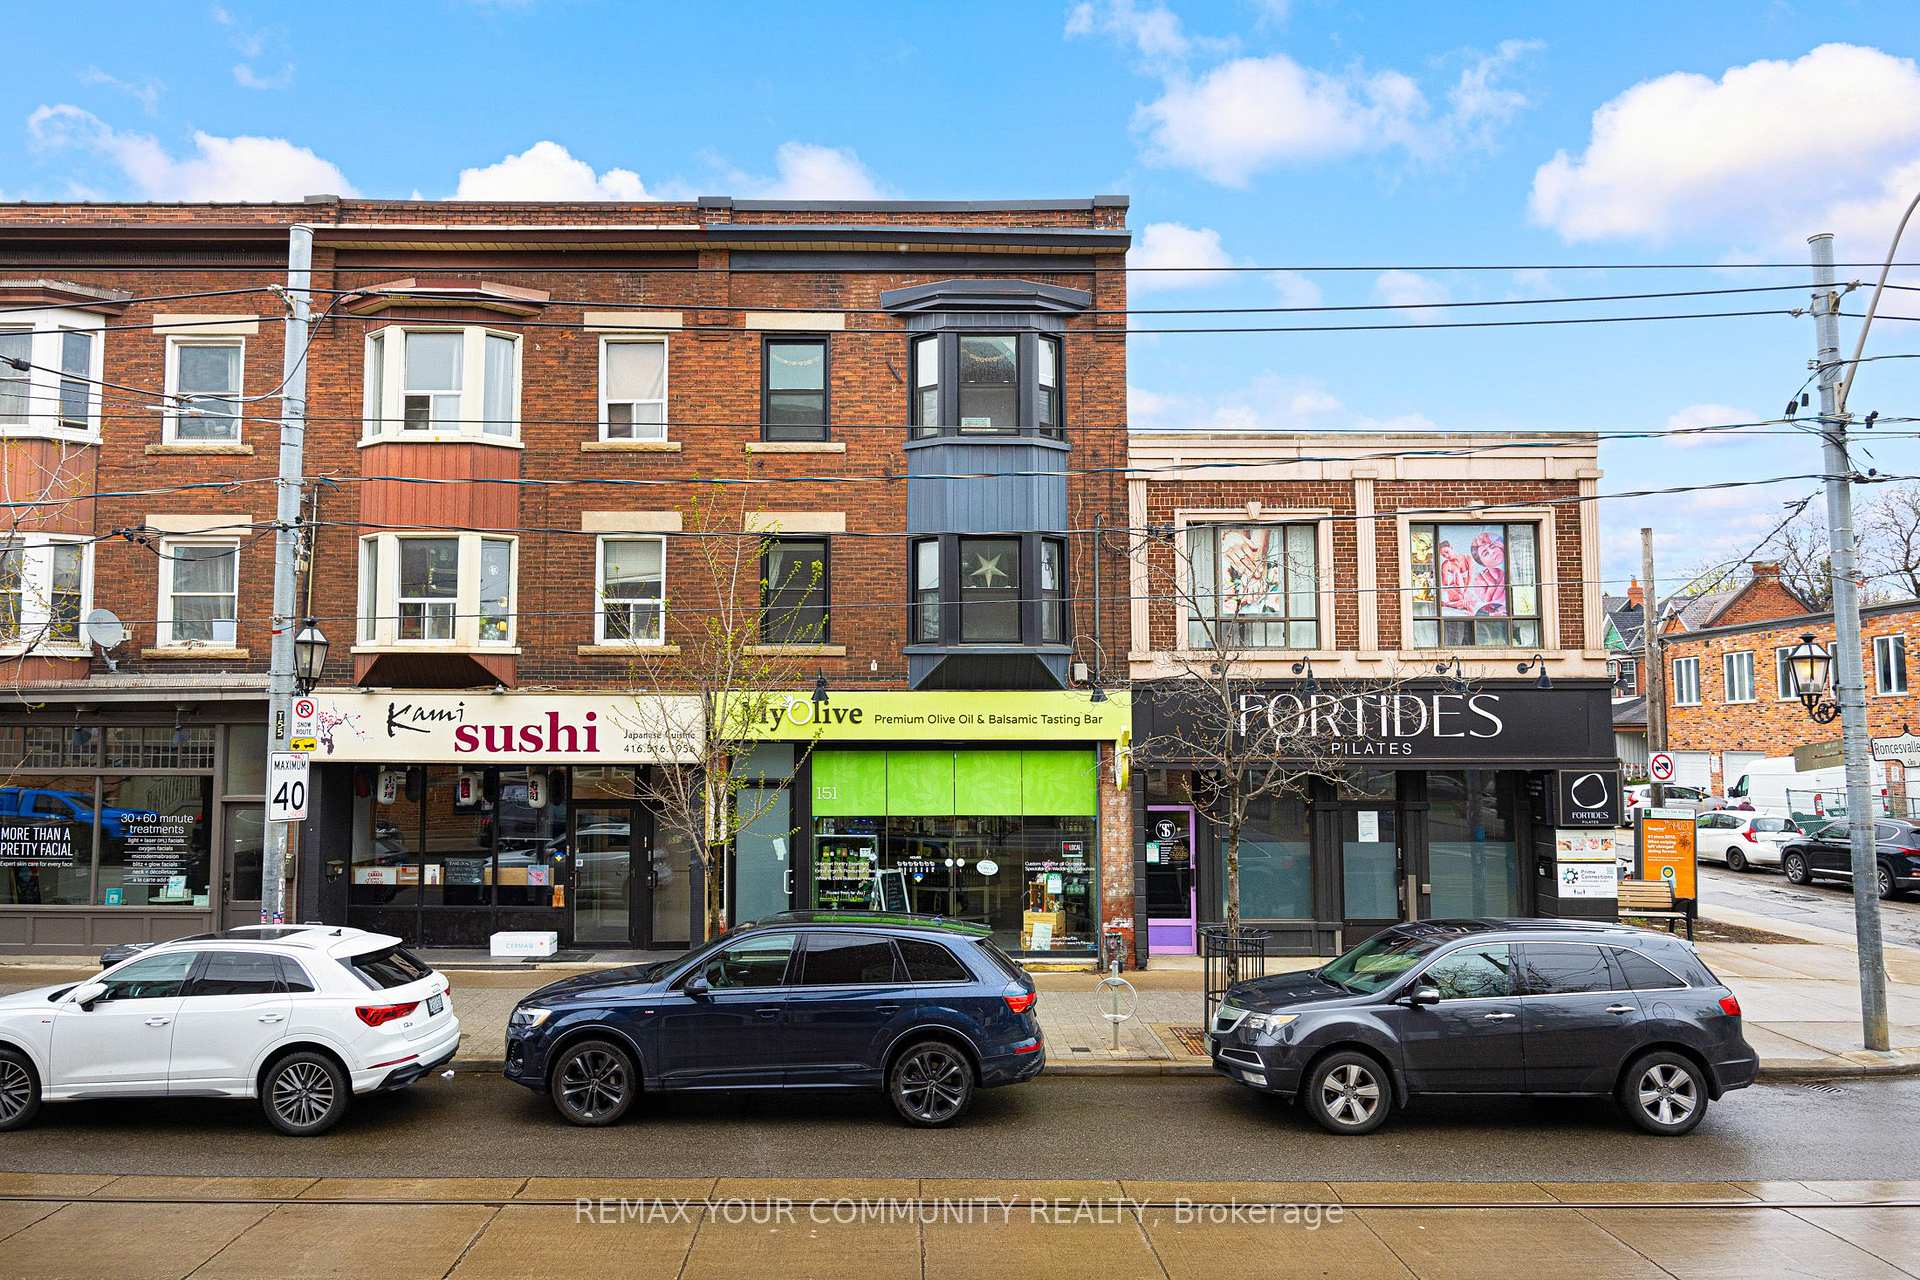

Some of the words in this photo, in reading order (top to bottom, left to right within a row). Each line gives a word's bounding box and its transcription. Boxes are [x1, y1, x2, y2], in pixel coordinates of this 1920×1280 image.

[386, 701, 466, 738] Kami
[874, 714, 925, 725] Premium
[927, 714, 956, 725] Olive
[958, 714, 974, 725] Oil
[976, 714, 985, 725] &
[988, 714, 1038, 725] Balsamic
[1040, 714, 1081, 727] Tasting
[1084, 714, 1103, 725] Bar
[1239, 694, 1503, 738] FORTIDES
[296, 728, 312, 736] ROUTE
[454, 711, 601, 753] sushi
[623, 729, 662, 740] Japanese
[623, 744, 696, 754] 416.516.956
[1331, 742, 1413, 755] PILATES
[274, 760, 307, 771] MAXIMUM
[272, 780, 306, 811] 40
[816, 786, 838, 800] 151
[159, 814, 195, 824] minute
[1572, 811, 1609, 820] FORTIDES
[1, 827, 31, 841] MORE
[33, 827, 62, 841] THAN
[63, 827, 72, 841] A
[129, 824, 185, 835] treatments
[0, 842, 38, 857] PRETTY
[40, 842, 74, 857] FACIAL
[0, 861, 16, 869] Expert
